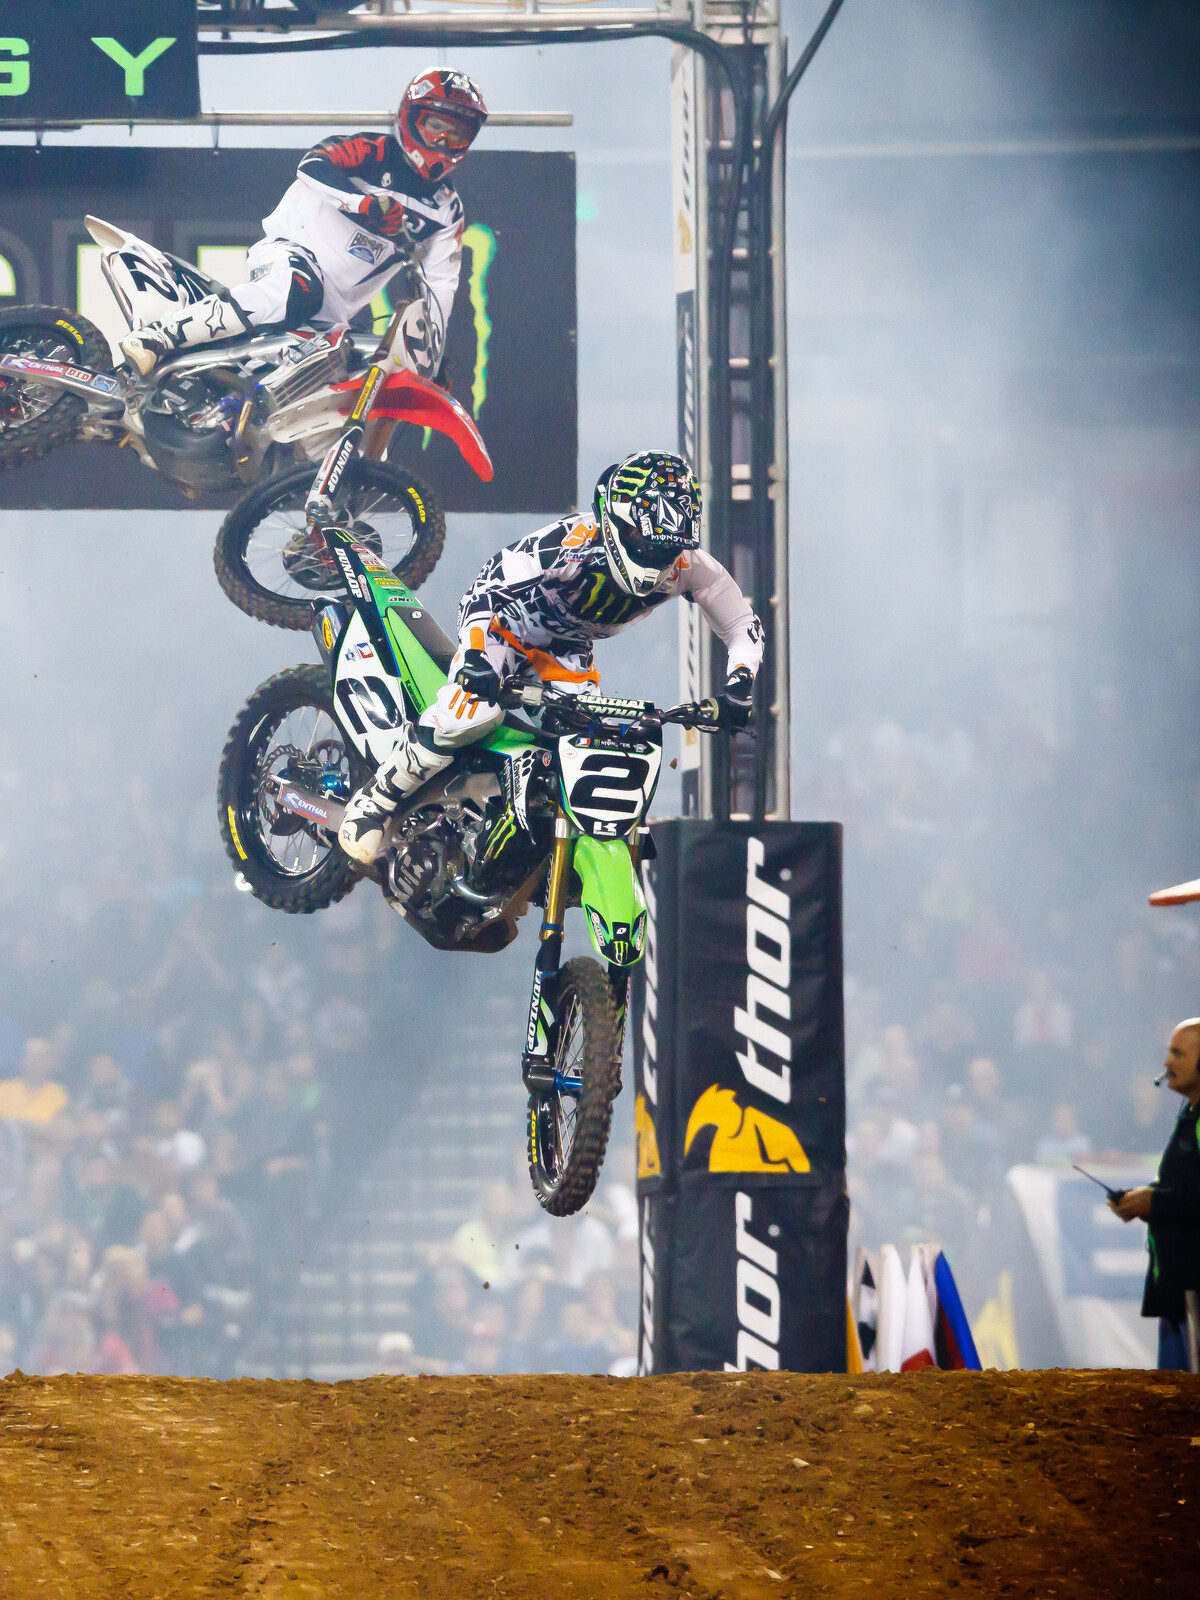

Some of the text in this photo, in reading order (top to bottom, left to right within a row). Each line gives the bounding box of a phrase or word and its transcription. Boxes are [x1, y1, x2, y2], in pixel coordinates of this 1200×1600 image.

[328, 439, 354, 494] DUNLOP
[334, 547, 363, 599] DUNLOP
[336, 675, 403, 735] 2
[569, 753, 650, 814] 2
[527, 968, 543, 1052] DUNLOP
